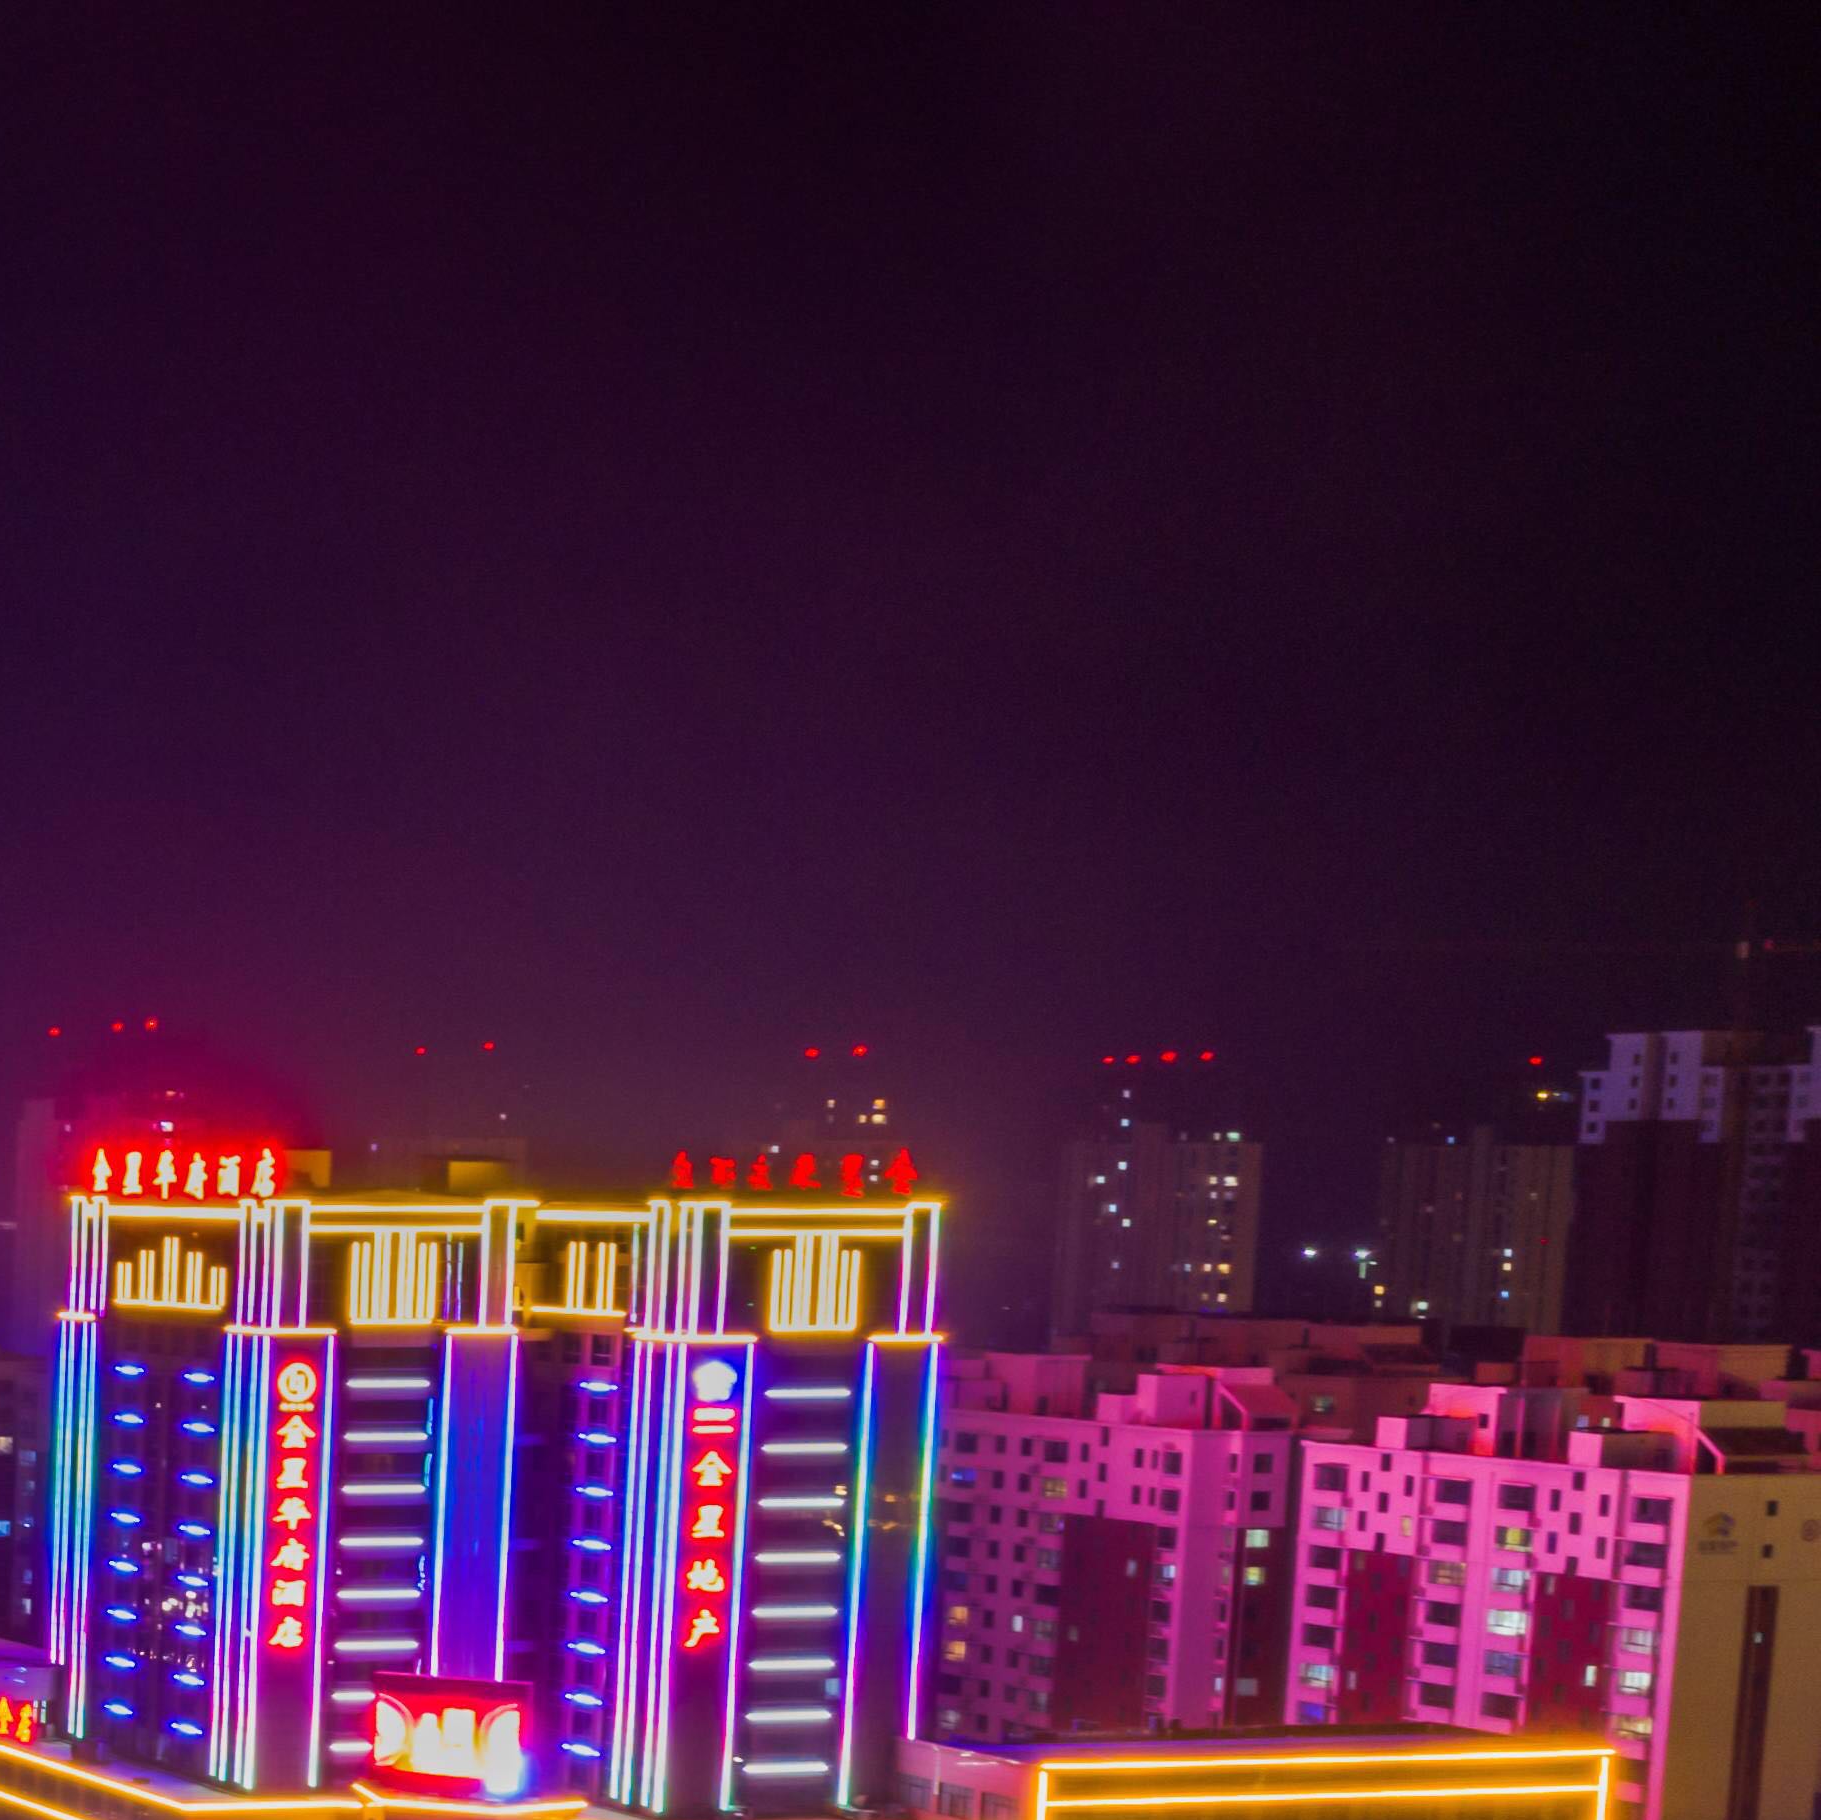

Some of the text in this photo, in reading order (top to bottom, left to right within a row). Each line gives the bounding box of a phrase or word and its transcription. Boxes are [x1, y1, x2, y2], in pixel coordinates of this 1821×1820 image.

[91, 1147, 276, 1200] 金星华府酒店
[268, 1414, 316, 1648] 金星华府酒店
